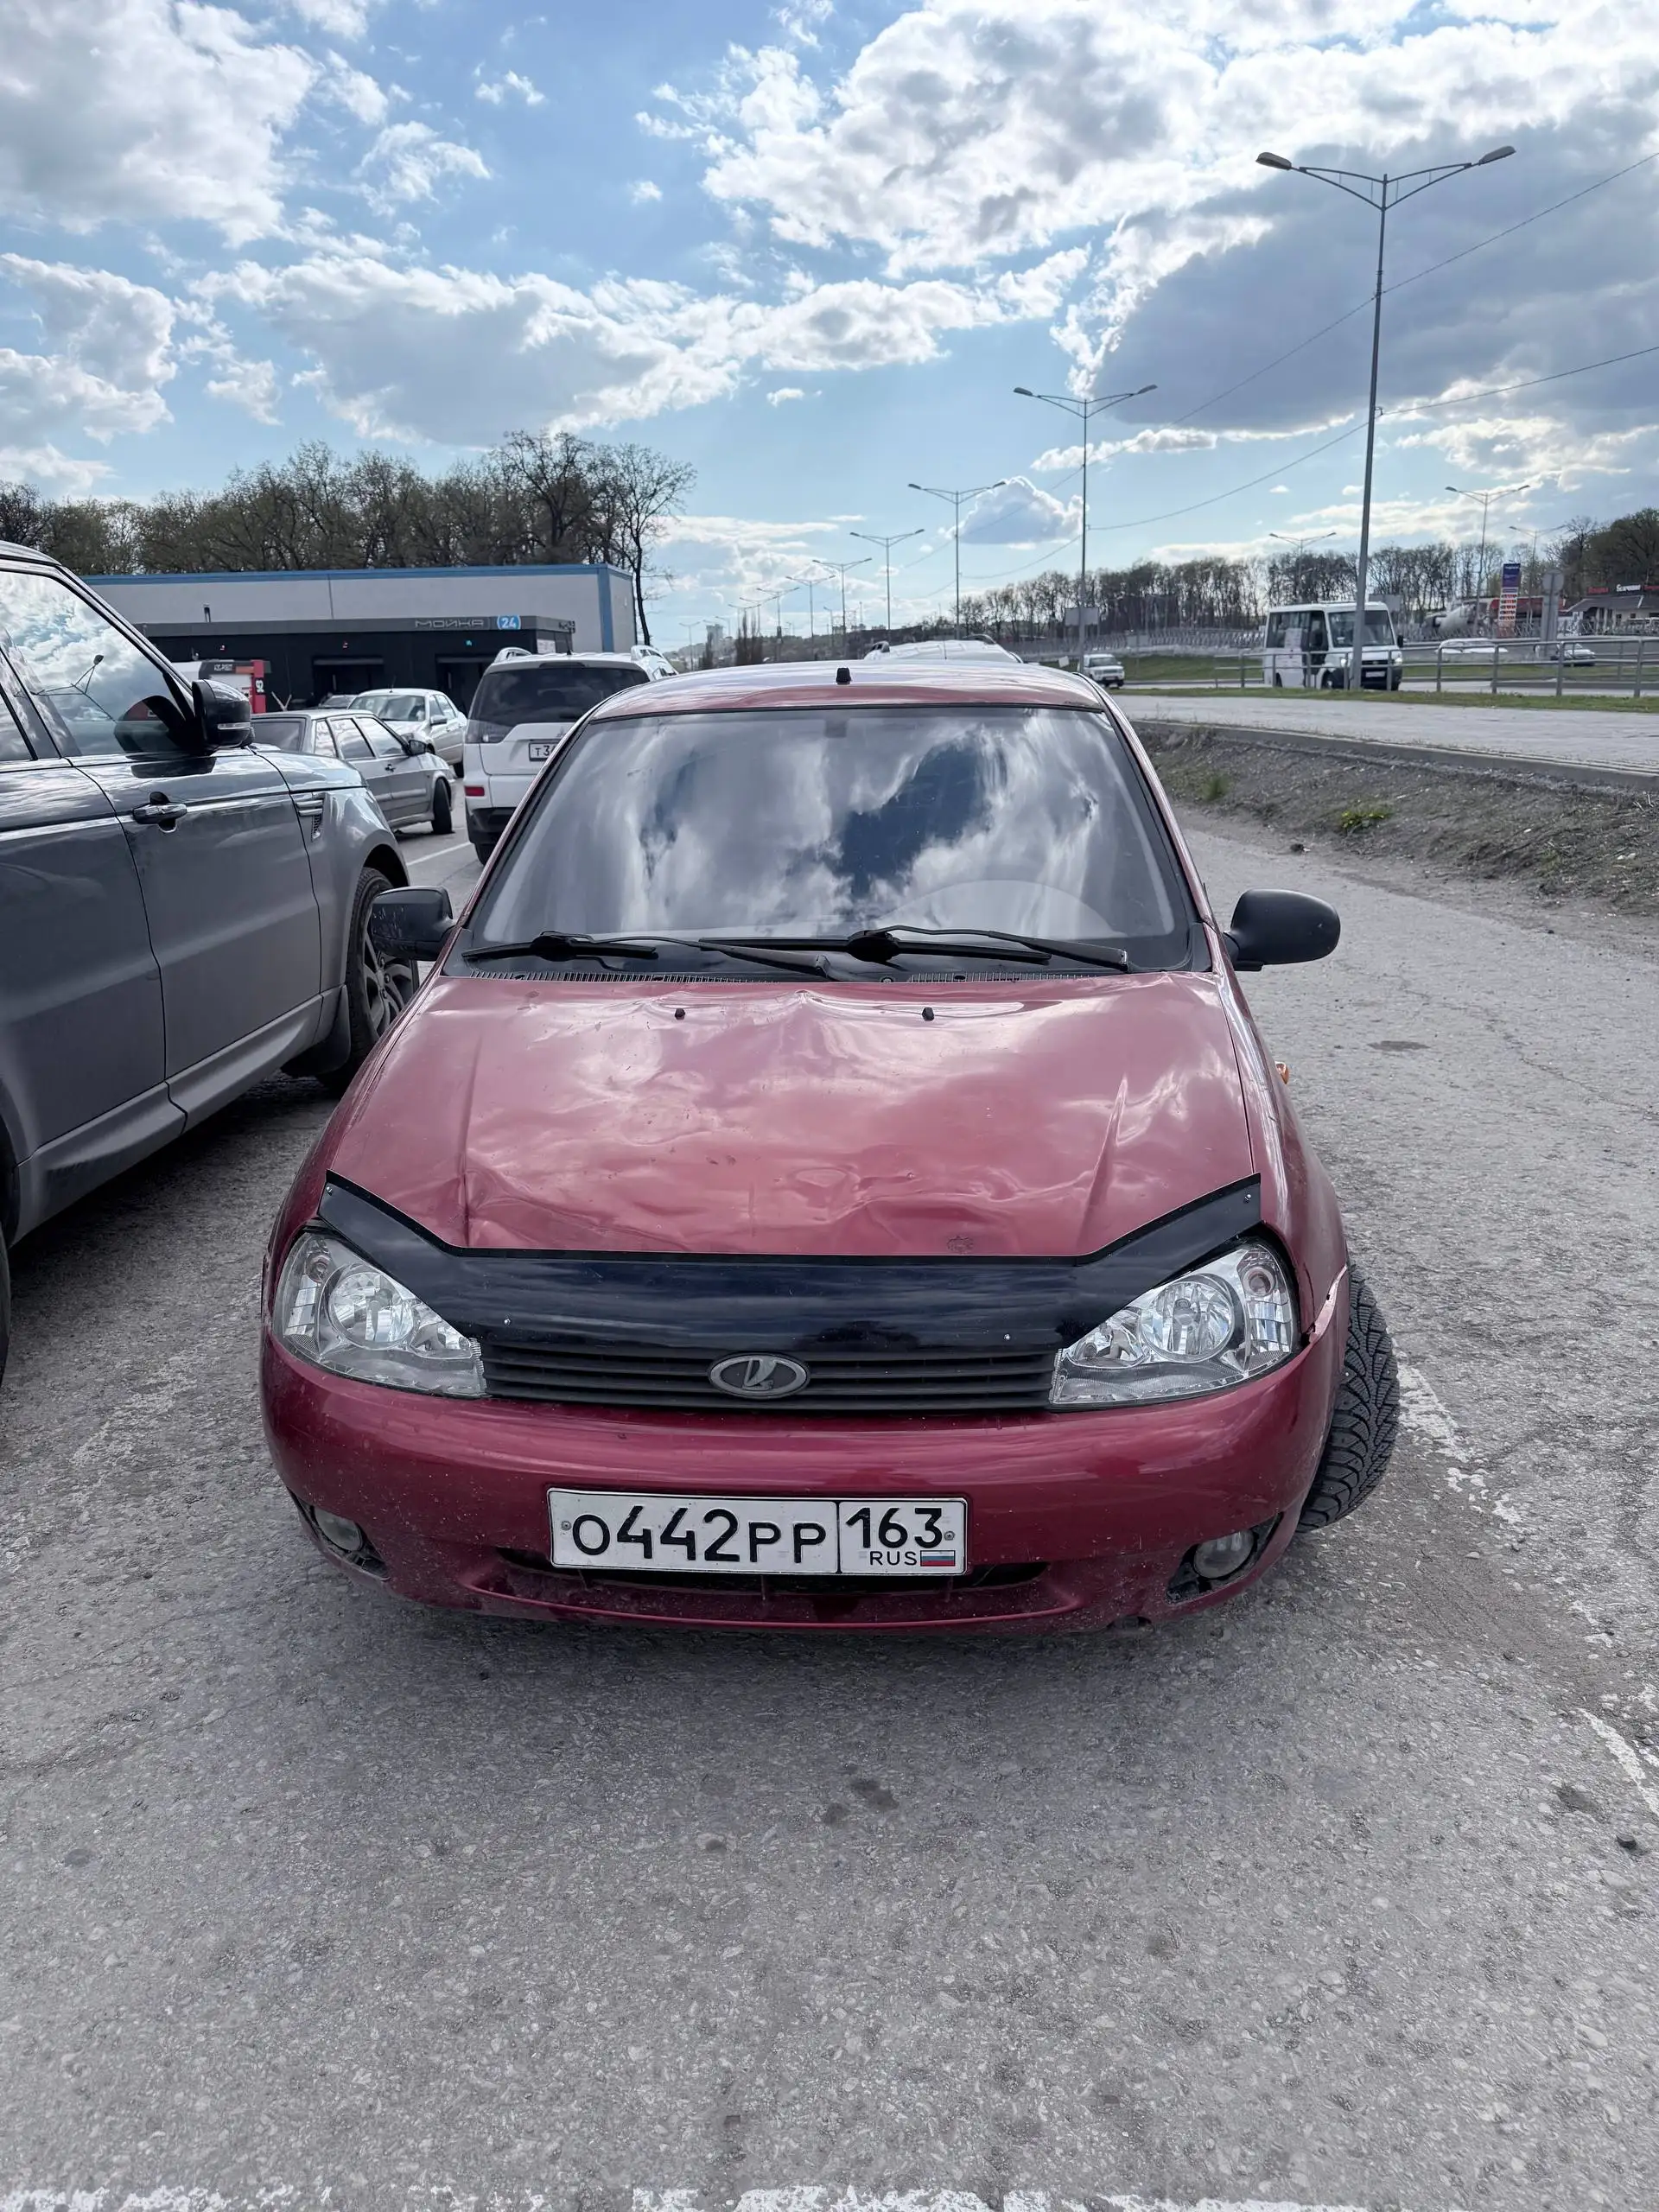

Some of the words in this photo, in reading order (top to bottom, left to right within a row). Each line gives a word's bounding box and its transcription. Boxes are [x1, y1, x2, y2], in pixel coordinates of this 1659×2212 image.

[415, 619, 484, 628] МОЙКА
[501, 617, 517, 628] 24
[846, 1508, 943, 1549] 163
[868, 1551, 918, 1567] RUS
